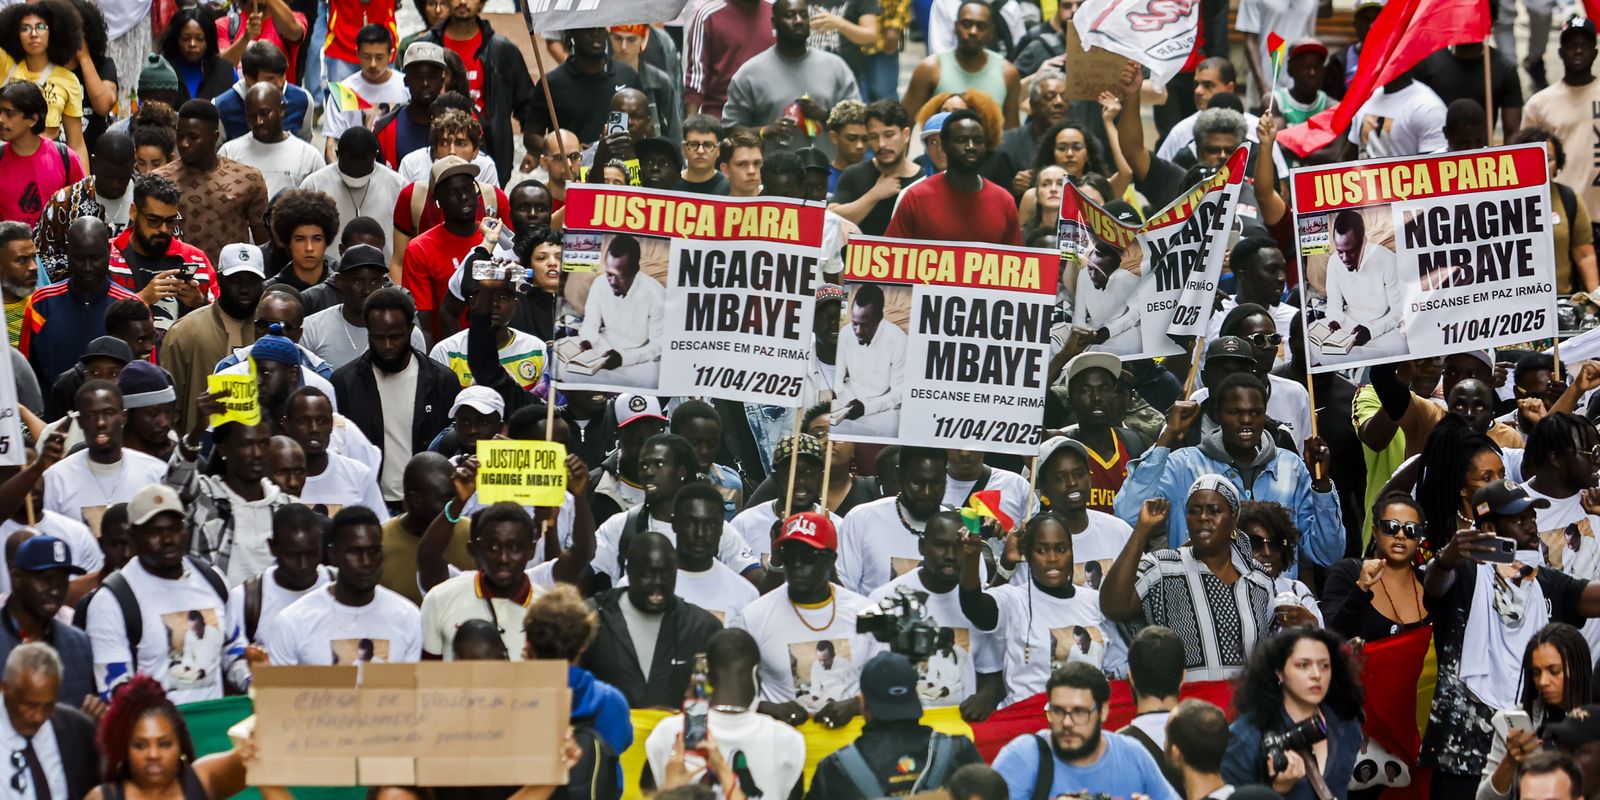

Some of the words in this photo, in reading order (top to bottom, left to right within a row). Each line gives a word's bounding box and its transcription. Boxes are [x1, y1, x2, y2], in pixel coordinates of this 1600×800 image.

[1314, 162, 1434, 207] JUSTIÇA
[1438, 154, 1519, 192] PARA
[590, 193, 716, 240] JUSTIÇA
[723, 206, 799, 240] PARA
[1404, 195, 1544, 249] NGAGNE
[678, 248, 818, 296] NGAGNE
[845, 244, 956, 287] JUSTIÇA
[963, 251, 1041, 289] PARA
[1418, 238, 1535, 292] MBAYE
[685, 292, 801, 340] MBAYE
[1411, 294, 1470, 312] DESCANSE
[1473, 292, 1489, 303] EM
[1492, 288, 1513, 300] PAZ
[1515, 282, 1552, 297] IRMÃO
[671, 340, 731, 351] DESCANSE
[734, 342, 750, 354] EM
[753, 345, 775, 357] PAZ
[925, 340, 1043, 388] MBAYE
[911, 388, 971, 403] DESCANSE
[973, 393, 990, 404] EM
[993, 395, 1015, 406] PAZ
[486, 448, 530, 471] JUSTIÇA
[534, 450, 557, 470] POR
[526, 474, 563, 487] MBAYE
[1086, 488, 1116, 506] EVE
